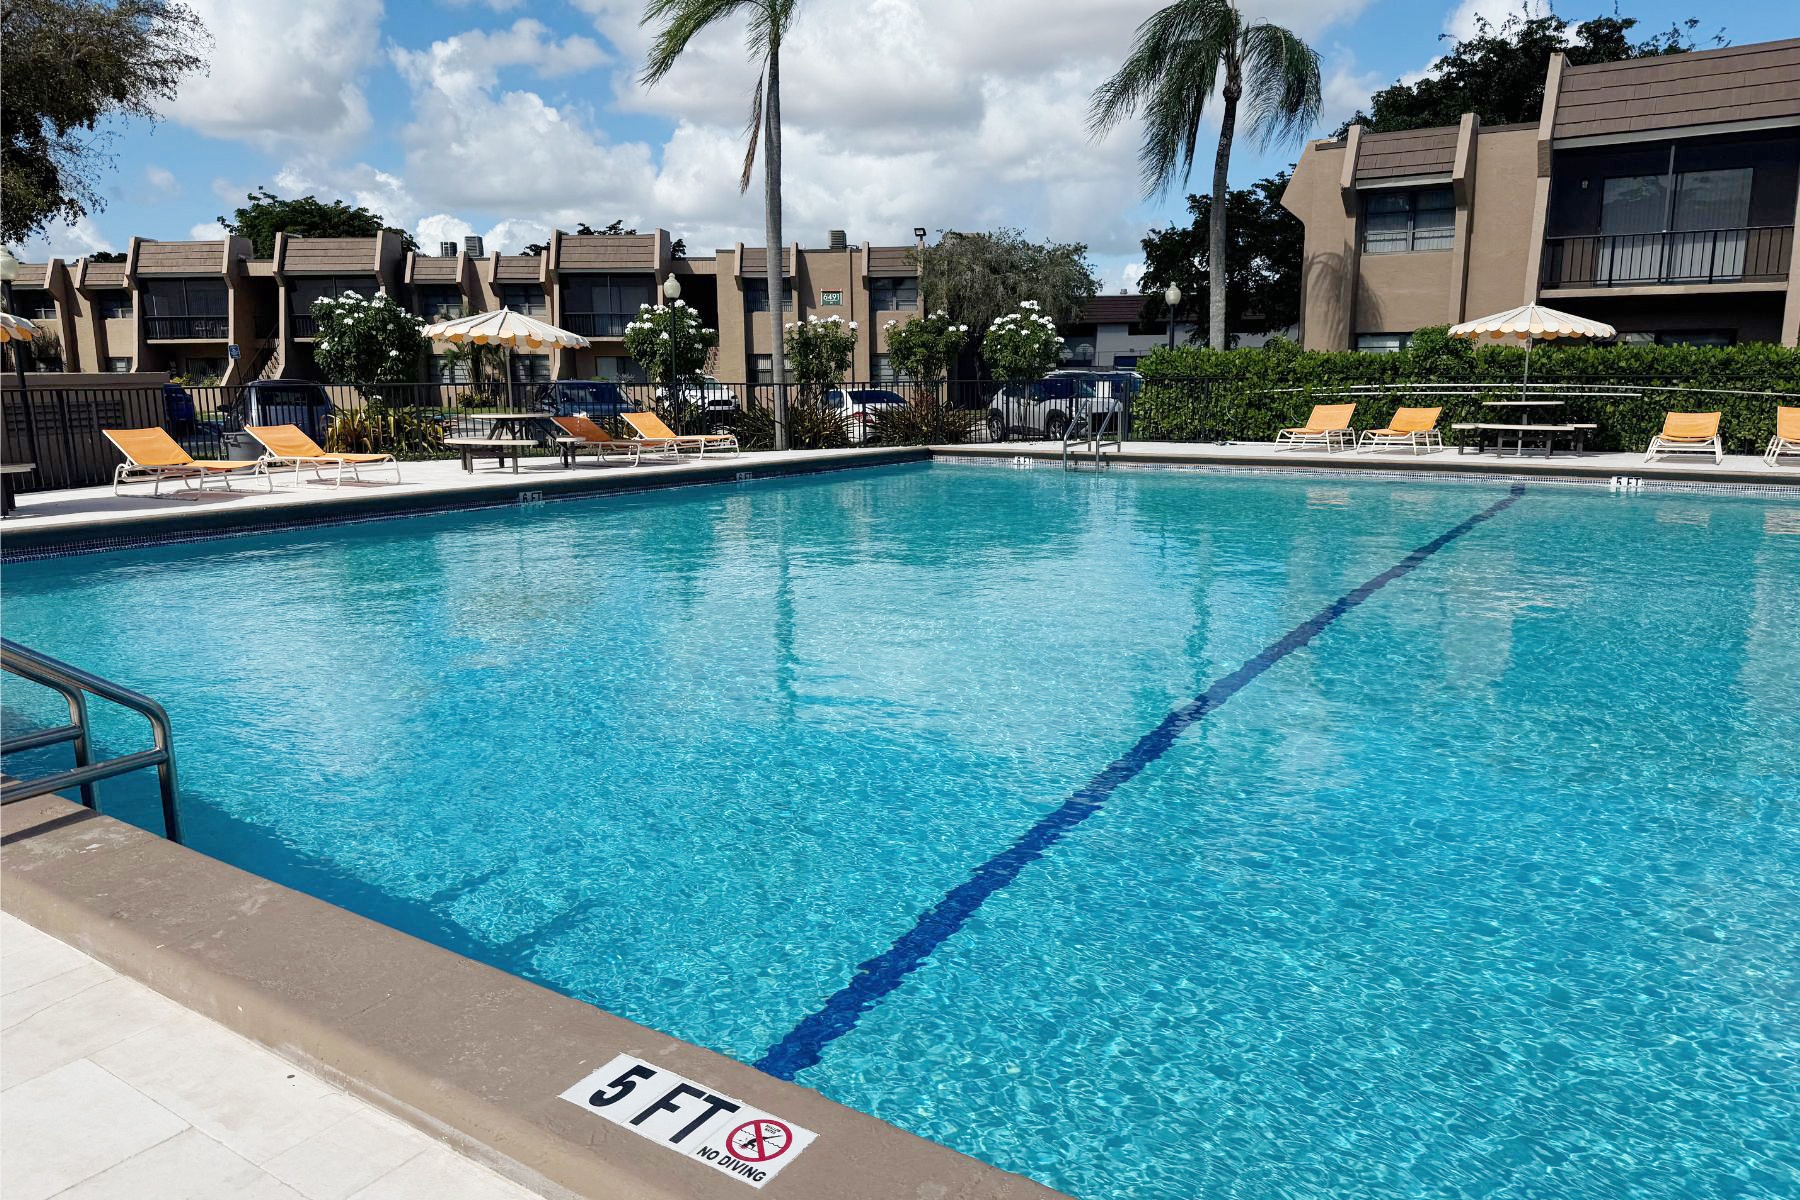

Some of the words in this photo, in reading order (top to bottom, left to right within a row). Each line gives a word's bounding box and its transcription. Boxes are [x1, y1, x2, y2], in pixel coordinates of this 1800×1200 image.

[1616, 476, 1622, 486] 5
[1627, 477, 1640, 486] FT
[588, 1064, 658, 1107] 5
[629, 1082, 742, 1144] FT
[696, 1145, 720, 1161] NO
[717, 1155, 767, 1182] DIVING
